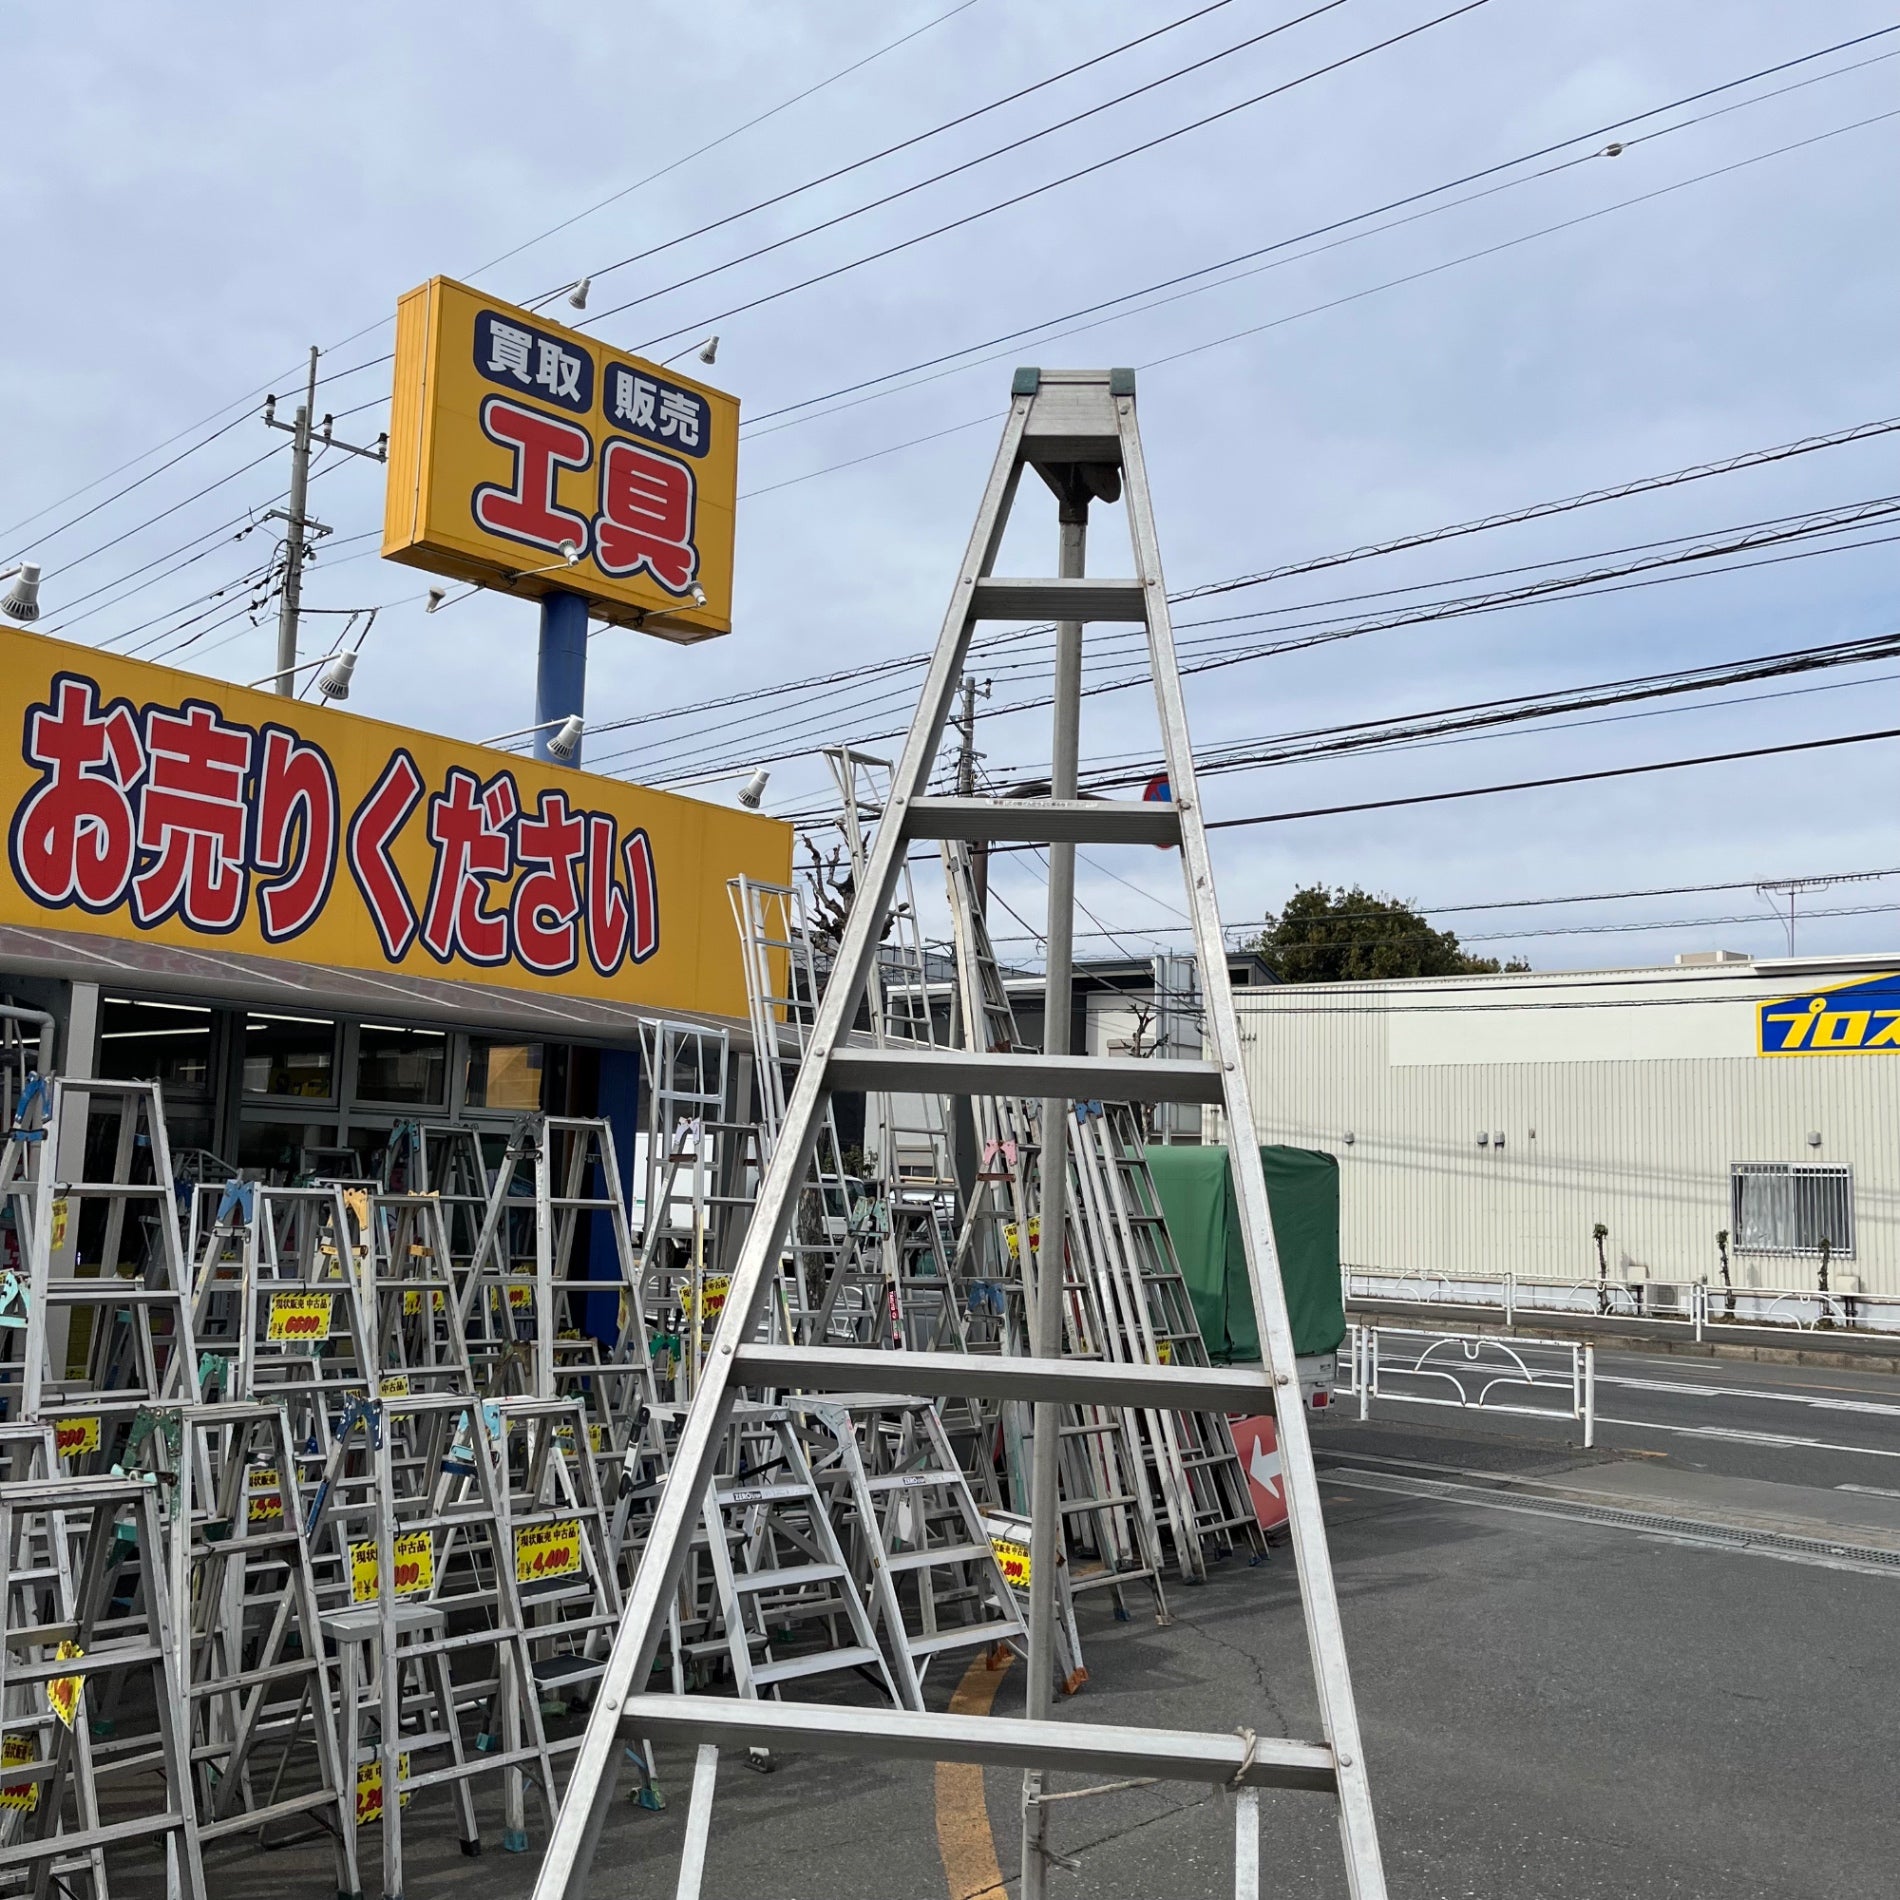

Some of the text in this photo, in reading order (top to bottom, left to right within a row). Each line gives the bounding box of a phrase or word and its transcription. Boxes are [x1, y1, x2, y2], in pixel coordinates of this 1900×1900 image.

[487, 319, 700, 447] 買取 販売
[471, 394, 699, 598] 工具
[9, 671, 659, 976] お売りください
[398, 1540, 427, 1556] 中古品
[553, 1527, 576, 1541] 中古品
